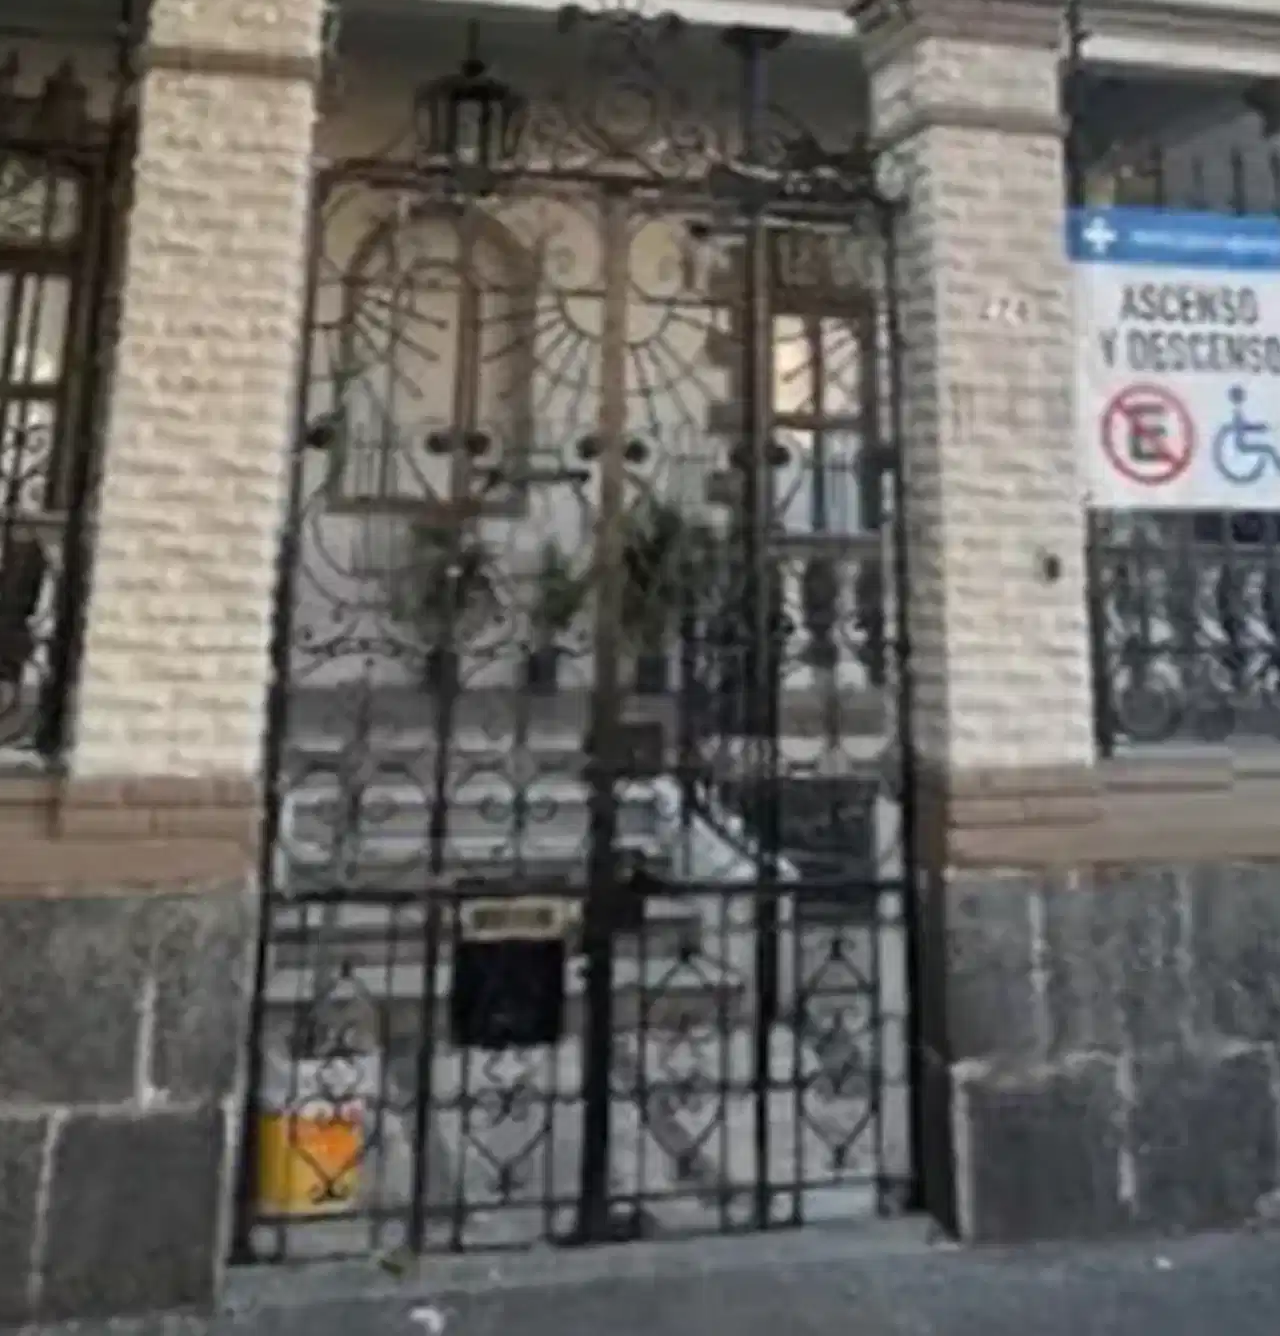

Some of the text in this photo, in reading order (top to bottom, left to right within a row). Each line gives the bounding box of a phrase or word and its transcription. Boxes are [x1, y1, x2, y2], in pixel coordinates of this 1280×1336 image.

[1121, 283, 1259, 326] ASCENSO
[1099, 329, 1117, 368] Y
[1129, 404, 1169, 462] E
